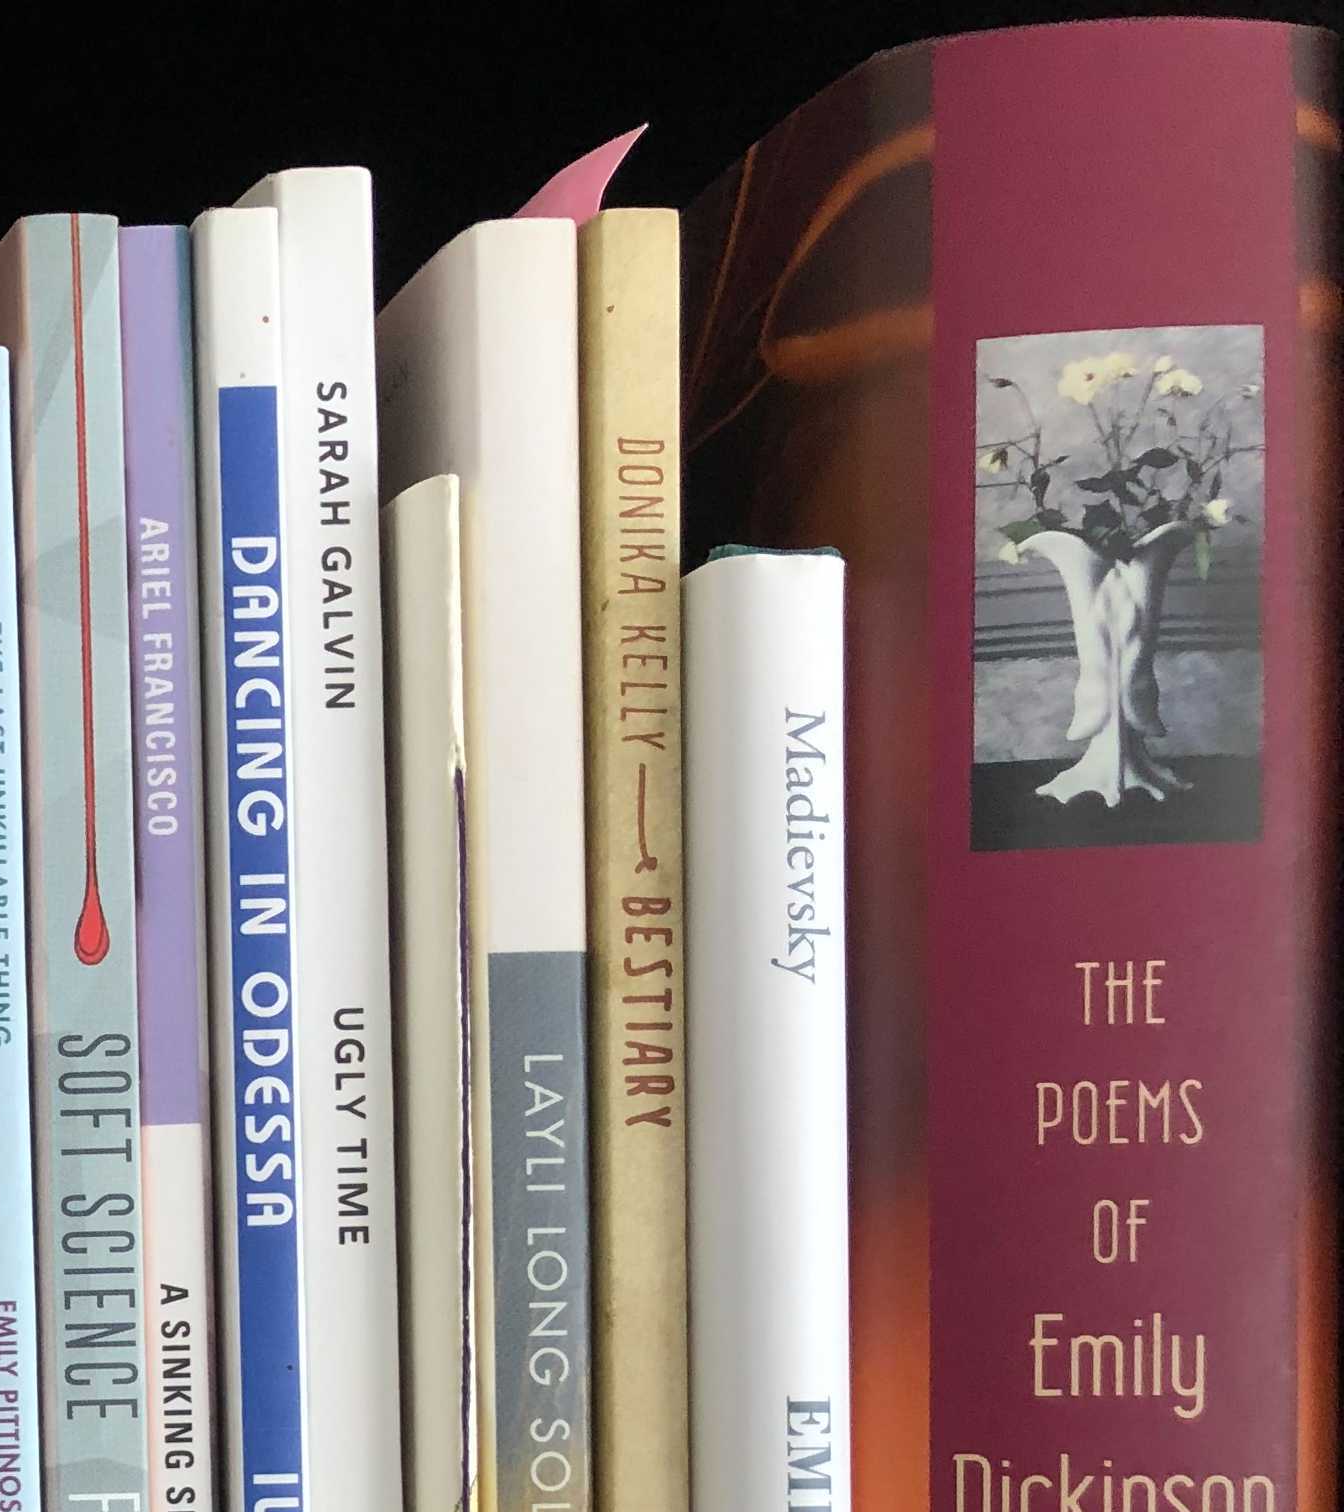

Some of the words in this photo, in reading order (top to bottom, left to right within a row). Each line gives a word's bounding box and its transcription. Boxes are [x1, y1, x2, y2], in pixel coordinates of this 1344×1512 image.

[315, 381, 351, 527] SARAH
[616, 437, 666, 598] DONIKA
[138, 516, 170, 621] ARIEL
[320, 545, 356, 711] GALVIN
[141, 632, 180, 838] FRANCISCO
[230, 536, 288, 839] DANCING
[620, 624, 668, 752] KELLY
[238, 871, 288, 936] IN
[770, 707, 832, 985] Madievsky
[621, 895, 676, 1130] BESTIARY
[1075, 960, 1166, 1026] THE
[56, 1032, 133, 1163] SOFT
[241, 971, 294, 1228] ODESSA
[333, 1007, 368, 1121] UGLY
[522, 1052, 566, 1193] LAYLI
[1035, 1079, 1205, 1146] POEMS
[336, 1138, 370, 1246] TIME
[1092, 1198, 1150, 1263] OF
[60, 1192, 139, 1421] SCIENCE
[159, 1282, 189, 1307] A
[526, 1226, 571, 1388] LONG
[160, 1319, 196, 1471] SINKING
[1029, 1312, 1206, 1419] Emily
